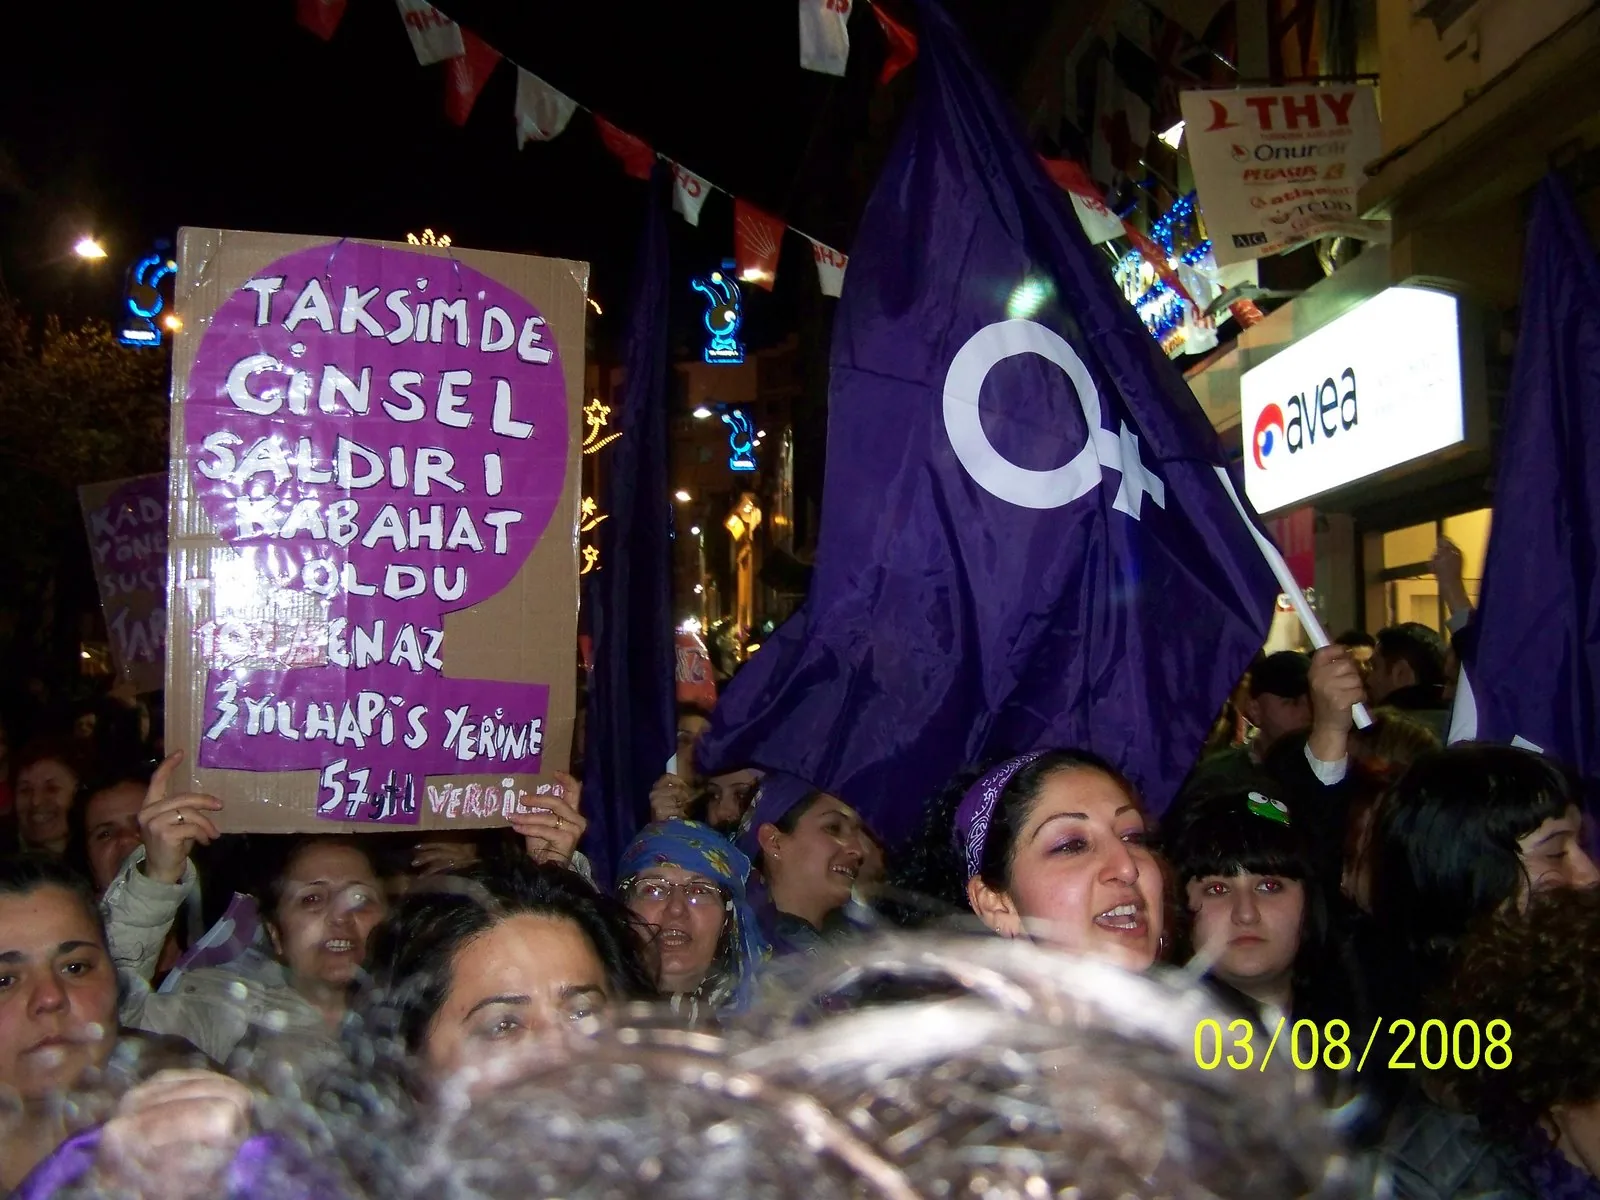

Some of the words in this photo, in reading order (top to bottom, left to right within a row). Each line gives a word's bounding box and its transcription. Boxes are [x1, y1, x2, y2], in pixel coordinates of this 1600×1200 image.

[1245, 92, 1355, 131] THY
[1287, 367, 1358, 454] avea
[197, 431, 503, 496] SALDIRI
[235, 495, 523, 554] KABAHAT
[302, 558, 466, 601] OLDU
